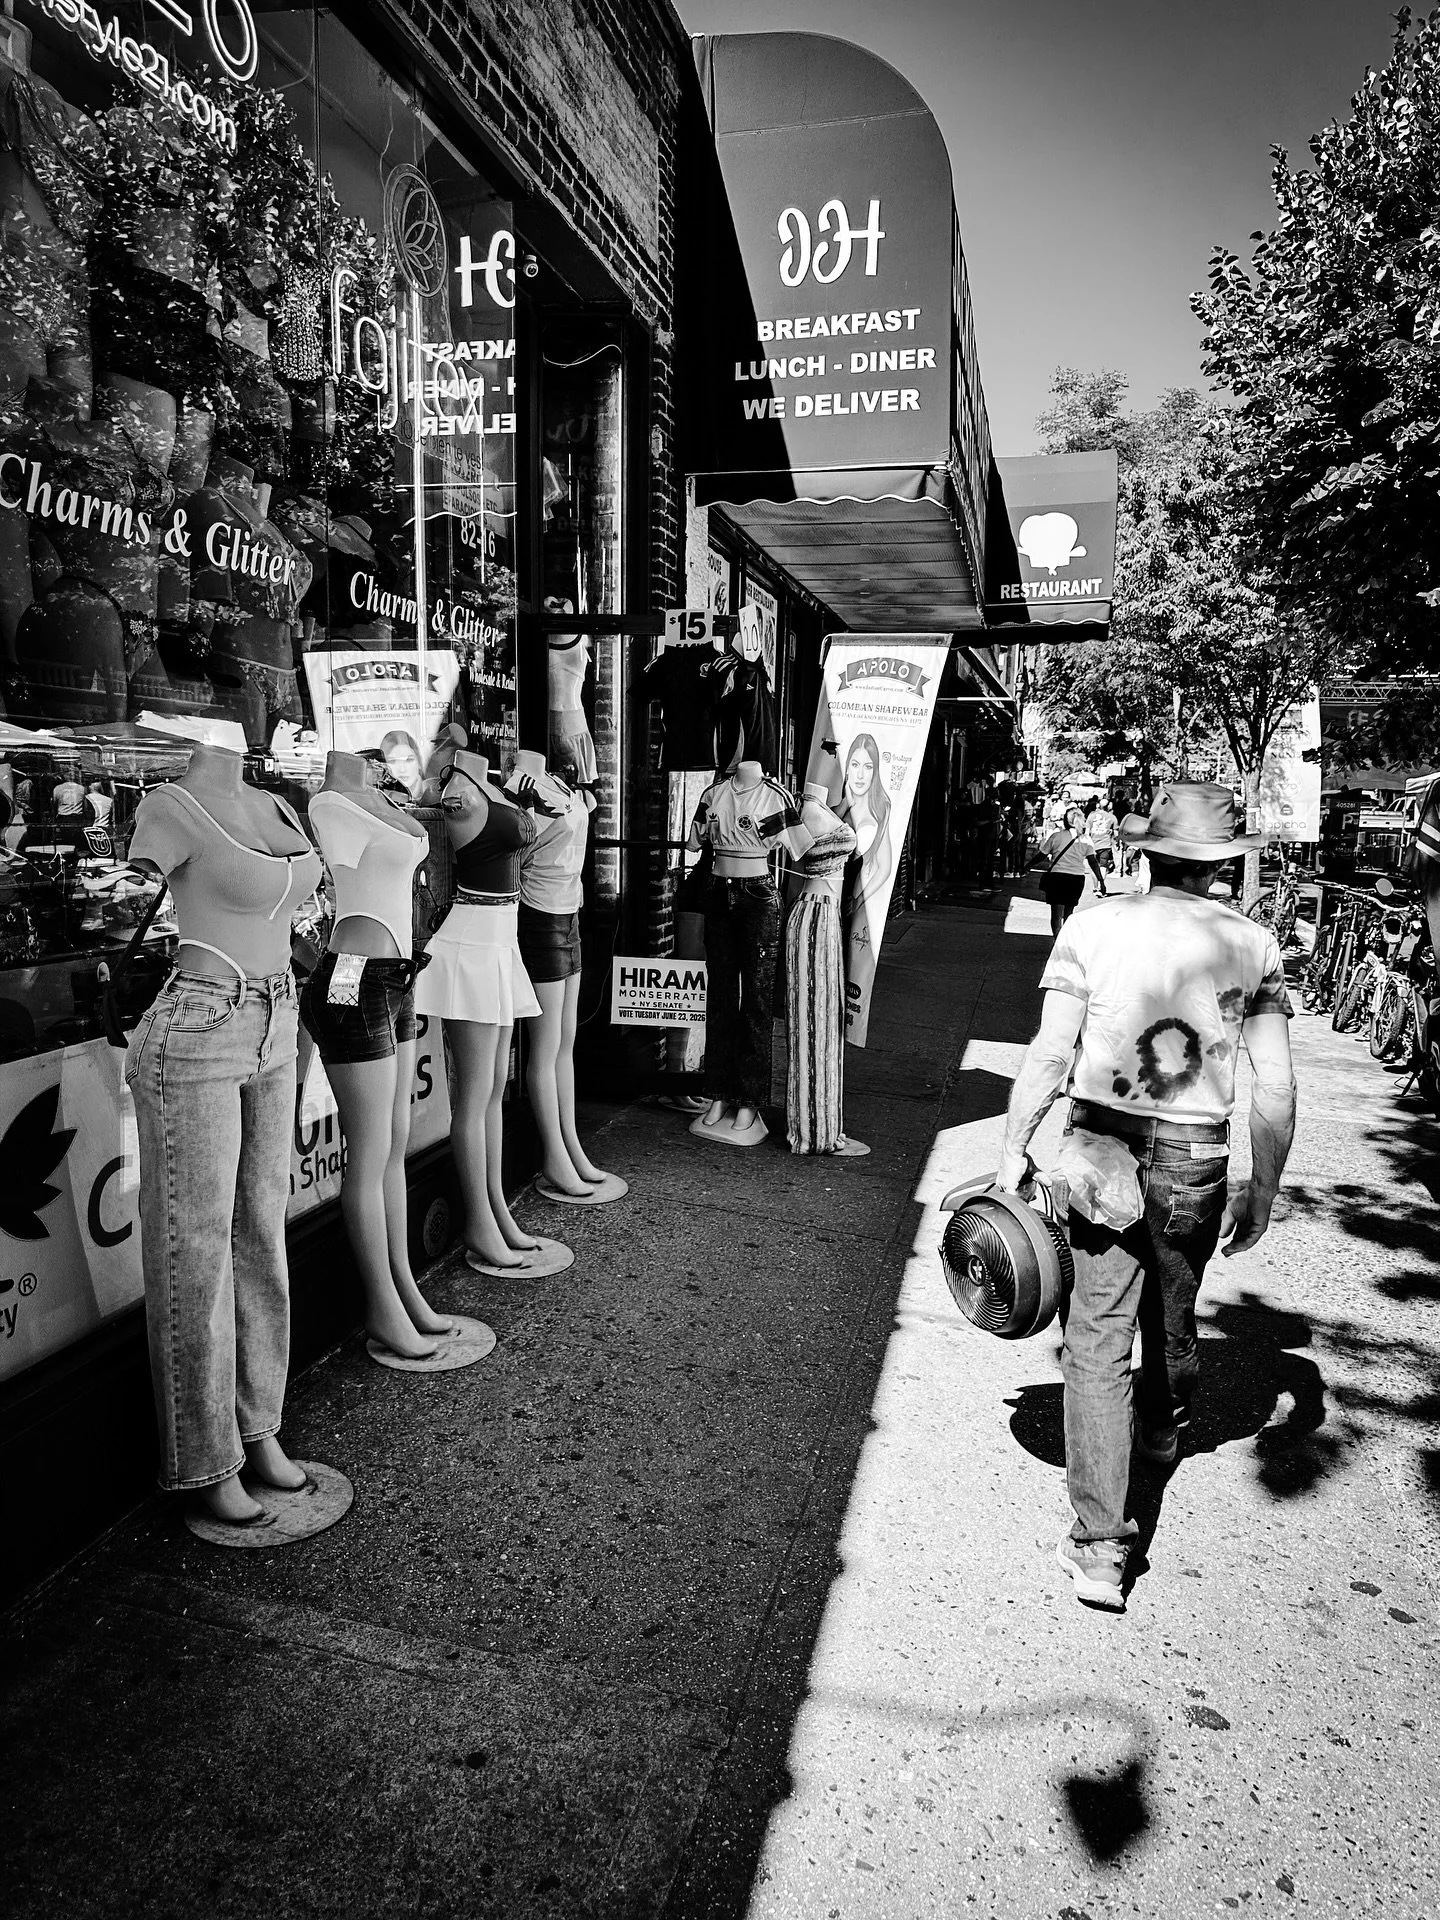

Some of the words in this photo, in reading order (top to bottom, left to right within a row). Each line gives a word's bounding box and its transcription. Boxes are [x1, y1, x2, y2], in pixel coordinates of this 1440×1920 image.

[757, 308, 921, 342] BREAKFAST
[735, 354, 826, 381] LUNCH
[850, 347, 937, 374] DINER
[743, 396, 786, 420] WE
[794, 388, 921, 418] DELIVER
[0, 453, 152, 546] Charms
[164, 508, 193, 558] &
[205, 521, 297, 586] Glitter
[1000, 577, 1104, 600] RESTAURANT
[350, 571, 423, 627] Charm
[431, 598, 446, 633] &
[451, 605, 499, 648] Glitter
[668, 611, 707, 641] $15
[856, 660, 910, 679] APOLO
[827, 701, 874, 713] COLOMBIAN
[874, 704, 929, 718] SHAPEWEAR
[620, 966, 707, 991] HIRAM
[618, 989, 706, 1001] MONSERRATE
[652, 1001, 684, 1009] SENATE
[618, 1009, 634, 1018] VOTE
[634, 1010, 660, 1020] TUESDAY
[661, 1012, 677, 1020] JUNE
[689, 1013, 706, 1022] 2026
